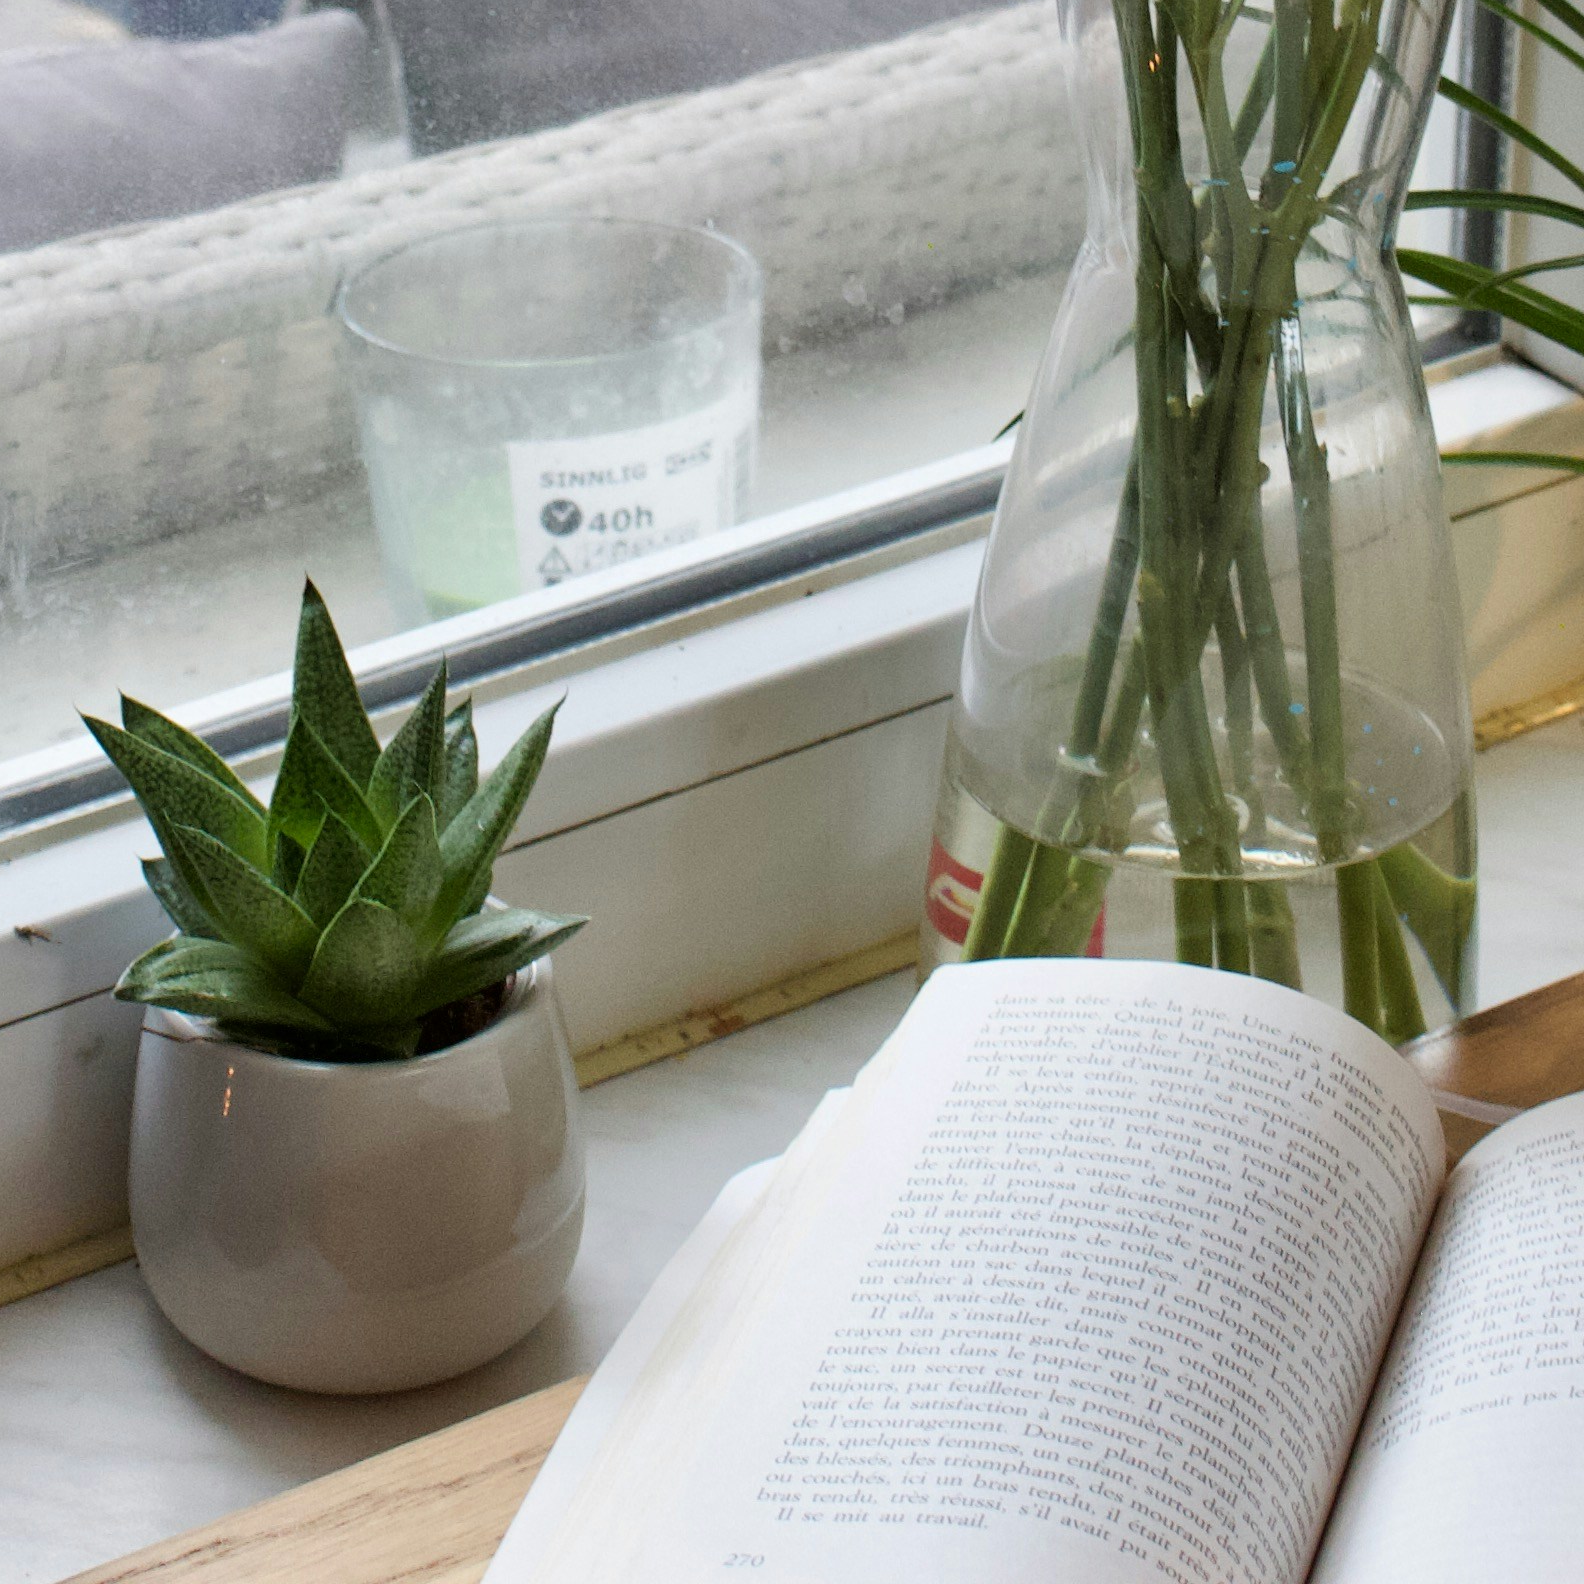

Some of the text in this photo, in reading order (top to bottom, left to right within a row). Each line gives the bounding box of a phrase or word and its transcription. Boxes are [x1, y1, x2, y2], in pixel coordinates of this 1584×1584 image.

[588, 505, 654, 535] 40h
[858, 1271, 1223, 1342] un cahier à dessin de grand format
[874, 1239, 922, 1252] sière
[930, 1237, 956, 1252] de
[965, 1238, 1050, 1257] charbon
[1196, 1279, 1212, 1296] Il
[1219, 1294, 1242, 1313] en
[866, 1258, 1282, 1362] caution un sac dans lequel il enveloppait
[870, 1305, 1164, 1356] Il alla s'installer dans son
[933, 1291, 1026, 1307] avait-elle
[1080, 1306, 1128, 1324] mais
[1137, 1320, 1204, 1351] contre
[834, 1327, 1170, 1378] crayon en prenant garde que les
[1490, 1362, 1514, 1376] de
[817, 1359, 836, 1374] le
[890, 1363, 916, 1374] un
[924, 1364, 986, 1376] secret
[994, 1368, 1024, 1380] est
[1033, 1371, 1060, 1385] un
[1146, 1397, 1163, 1415] Il
[826, 1341, 1254, 1452] toutes bien dans le papier qu'il serrait lui
[905, 1382, 939, 1395] par
[948, 1380, 1043, 1400] feuilleter
[1048, 1388, 1076, 1407] les
[1081, 1400, 1184, 1447] premières
[1459, 1396, 1514, 1415] serait
[1524, 1388, 1558, 1405] pas
[774, 1450, 810, 1466] des
[900, 1451, 936, 1466] des
[1088, 1480, 1124, 1504] des
[792, 1413, 818, 1429] de
[1022, 1422, 1094, 1450] Douze
[1104, 1445, 1193, 1496] planches
[801, 1395, 1239, 1510] vait de la satisfaction à mesurer le travail
[838, 1432, 931, 1451] quelques
[1032, 1447, 1060, 1462] un
[1144, 1485, 1213, 1535] surtout
[756, 1486, 802, 1503] bras
[890, 1490, 930, 1504] très
[1018, 1502, 1052, 1521] s'il
[1060, 1516, 1111, 1542] avait
[1118, 1538, 1148, 1561] pu
[765, 1473, 793, 1484] ou
[901, 1474, 926, 1486] ici
[936, 1475, 964, 1487] un
[972, 1473, 1019, 1494] bras
[1106, 1507, 1122, 1524] il
[1127, 1521, 1172, 1552] était
[1178, 1549, 1211, 1583] très
[774, 1506, 794, 1522] Il
[801, 1512, 824, 1523] se
[832, 1512, 870, 1523] mit
[878, 1513, 905, 1524] au
[722, 1552, 766, 1568] 270
